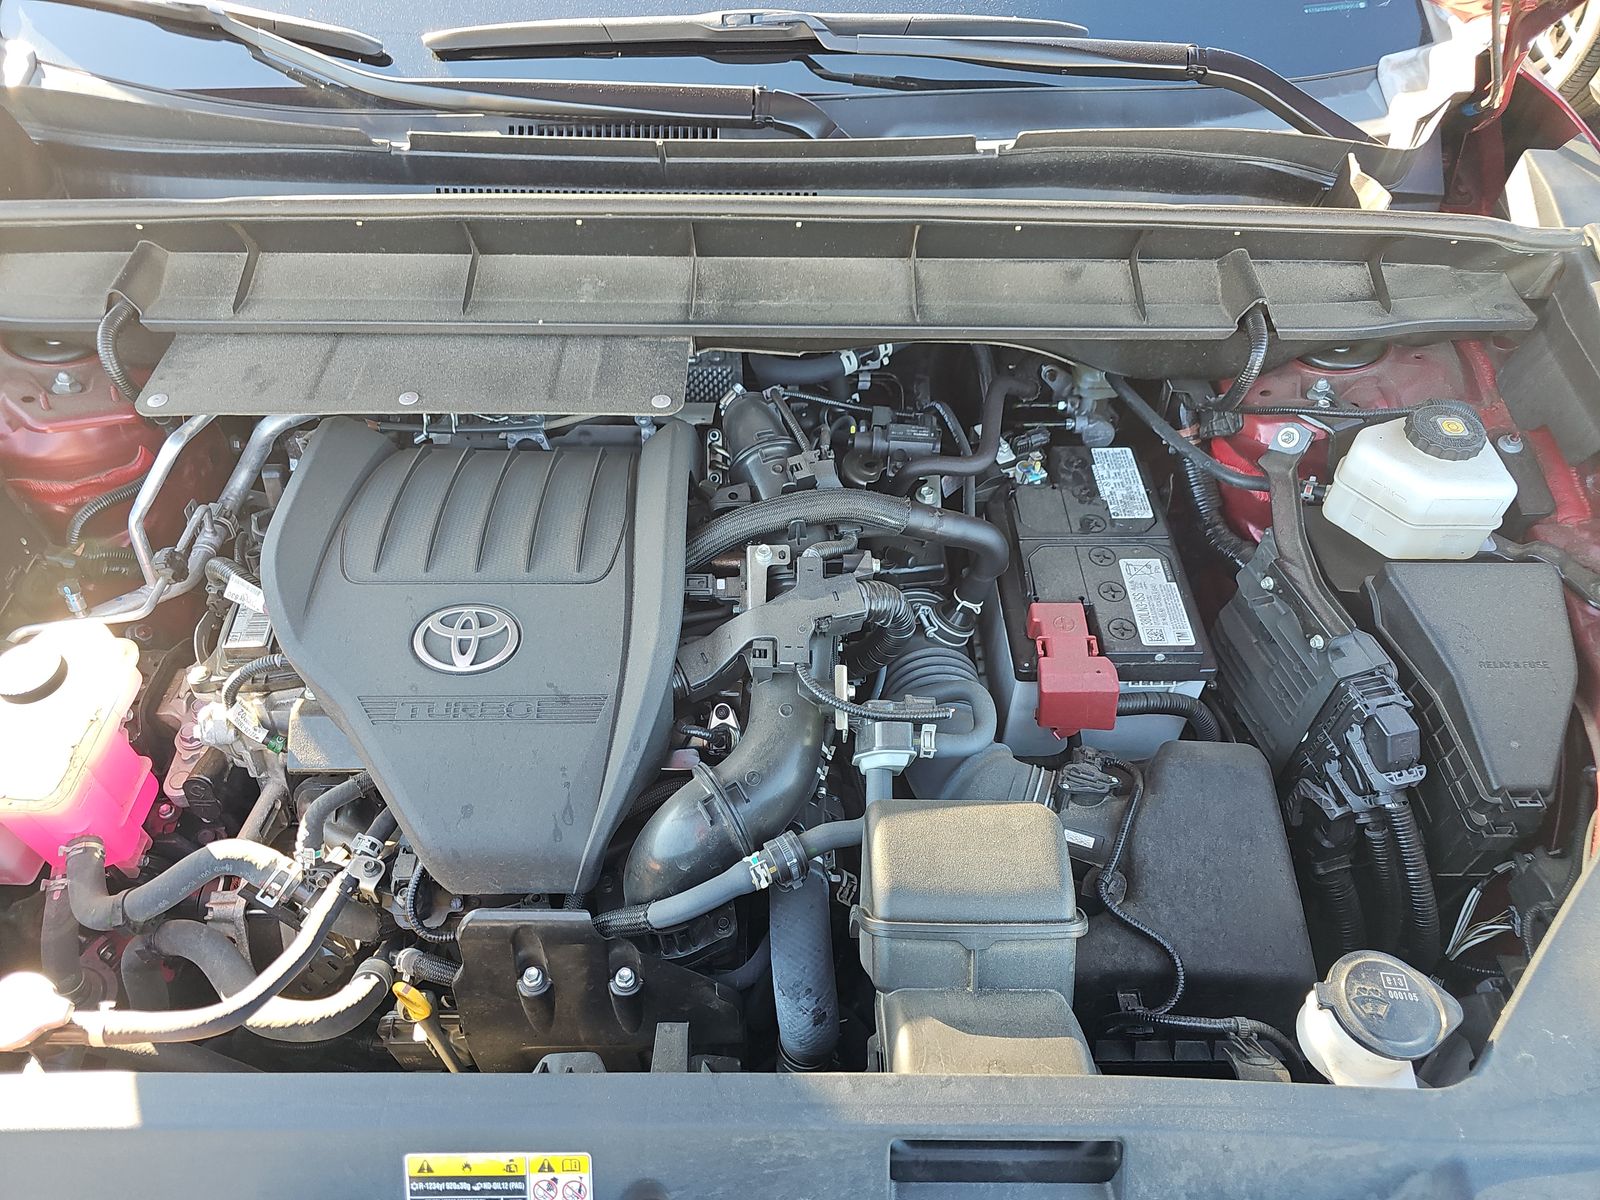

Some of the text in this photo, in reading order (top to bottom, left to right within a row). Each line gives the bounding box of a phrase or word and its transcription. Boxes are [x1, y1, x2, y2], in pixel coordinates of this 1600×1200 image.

[1522, 660, 1550, 669] FUSE
[401, 701, 534, 719] TURBO
[1388, 990, 1419, 1002] 000105
